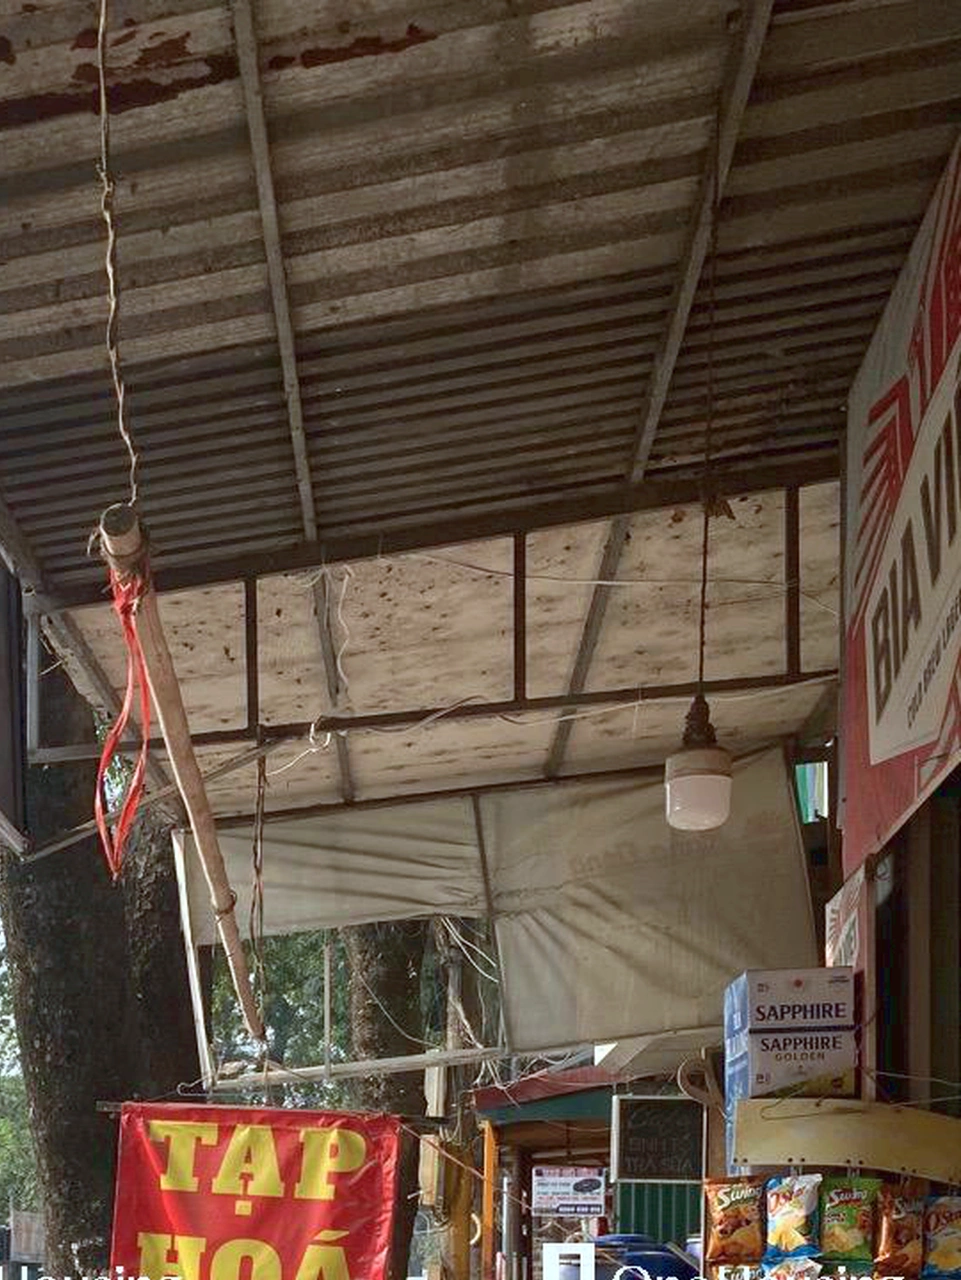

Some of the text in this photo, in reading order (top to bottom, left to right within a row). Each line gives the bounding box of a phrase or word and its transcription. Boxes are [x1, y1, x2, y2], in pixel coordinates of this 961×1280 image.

[871, 516, 922, 726] BIA
[755, 1002, 848, 1022] SAPPHIRE
[760, 1034, 843, 1052] SAPPHIRE
[775, 1052, 825, 1062] GOLDEN
[149, 1119, 368, 1216] TẠP
